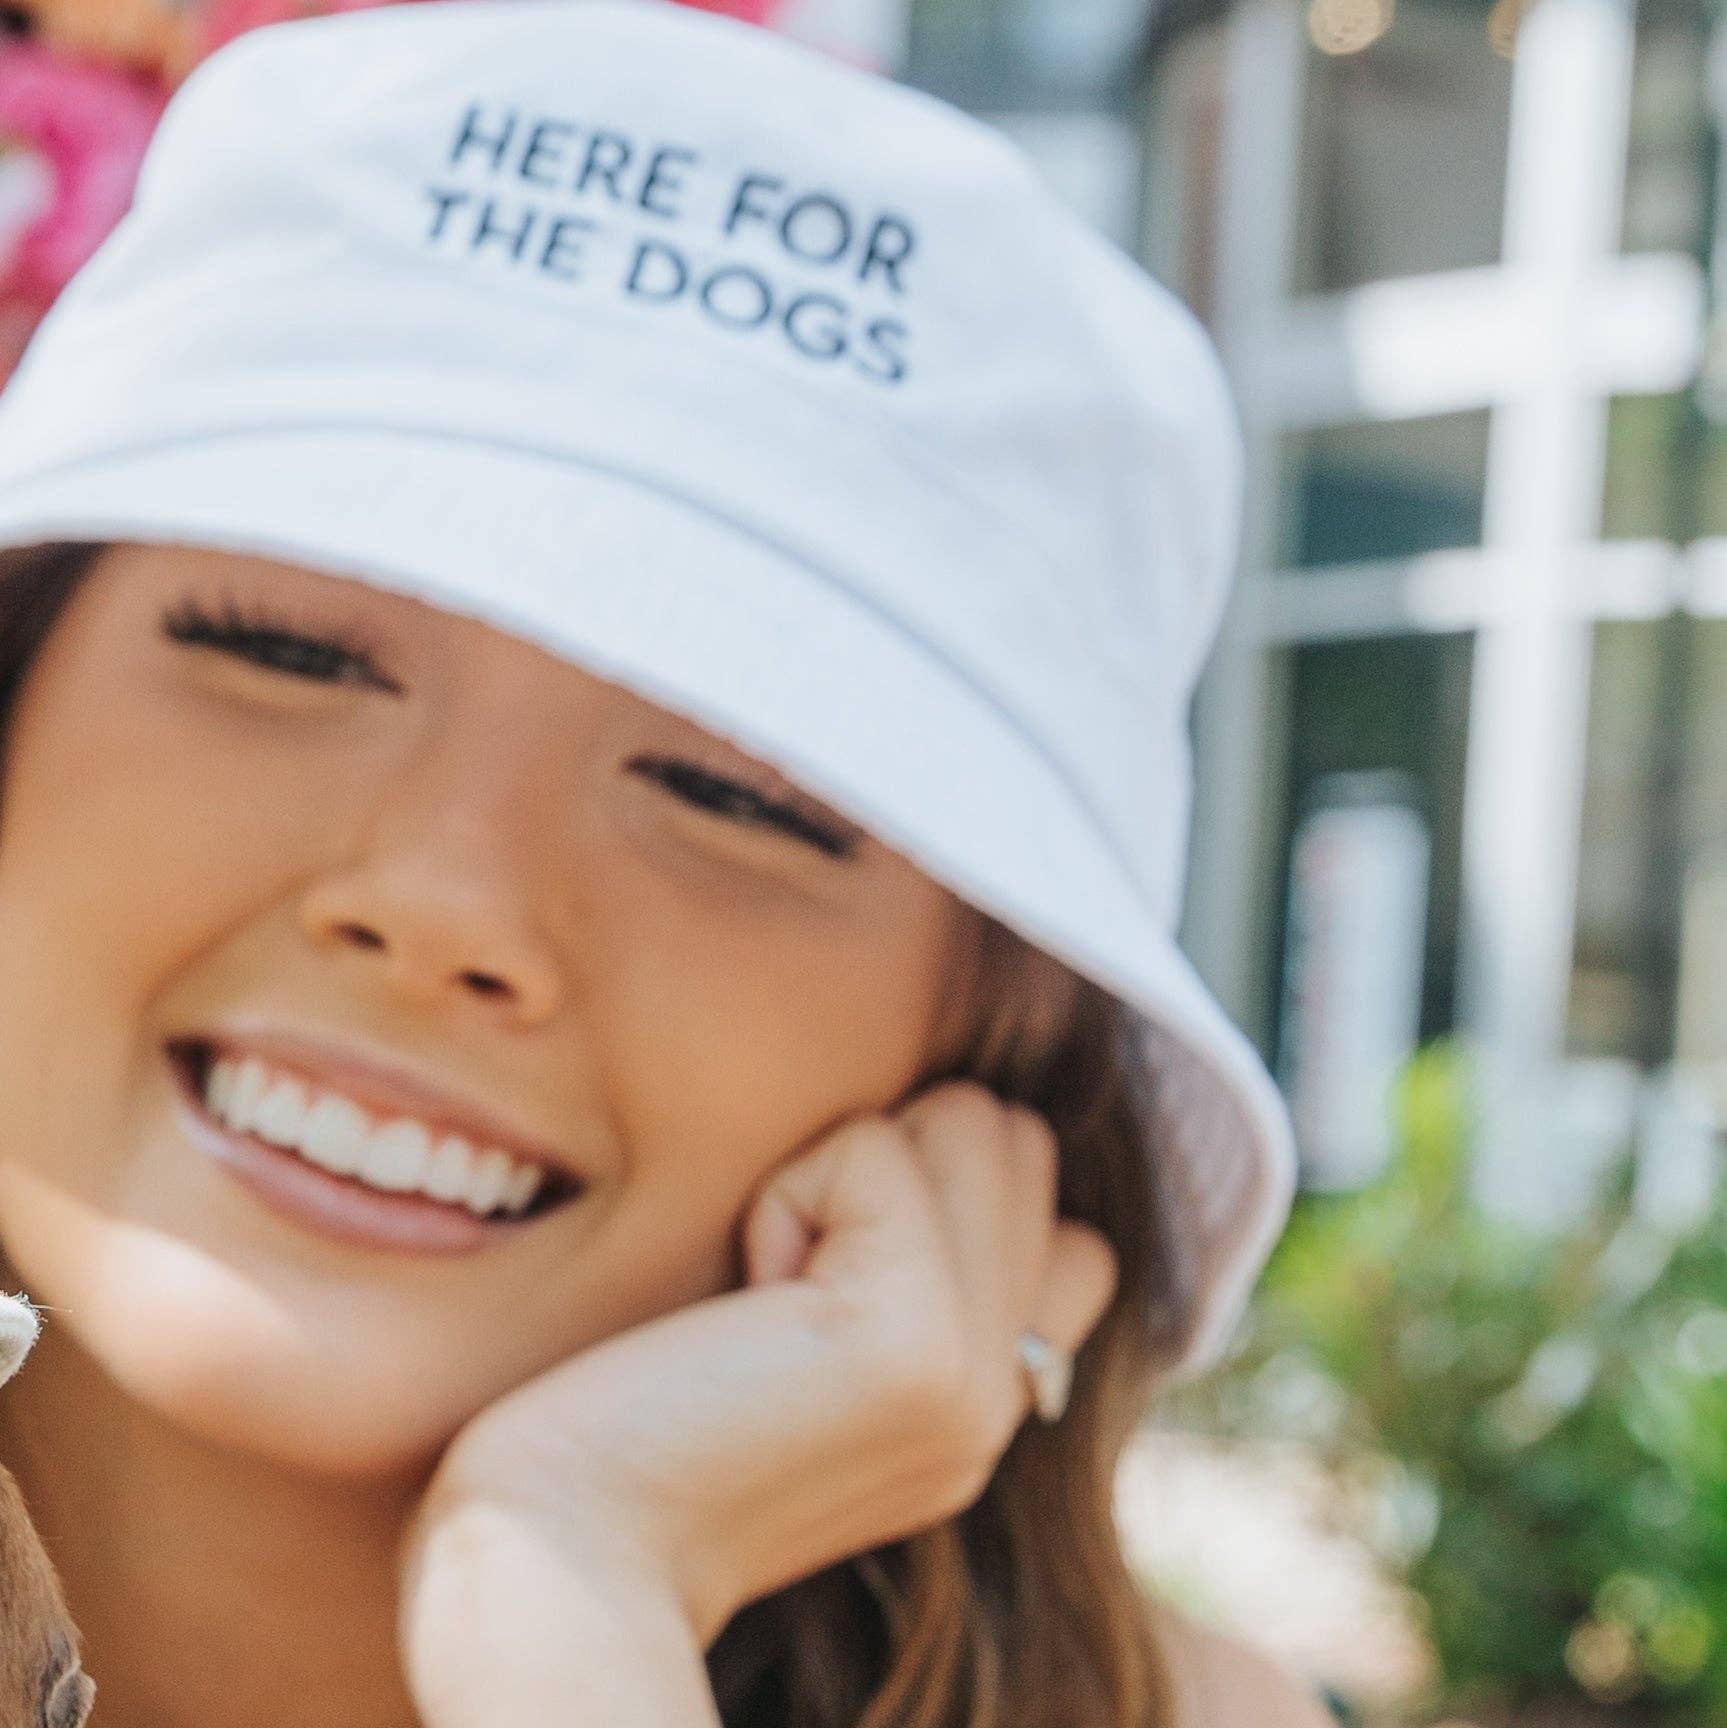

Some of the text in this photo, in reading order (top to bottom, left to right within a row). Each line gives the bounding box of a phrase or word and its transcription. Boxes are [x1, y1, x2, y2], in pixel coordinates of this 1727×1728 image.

[424, 187, 908, 385] THE DOGS
[447, 103, 917, 294] HERE FOR
